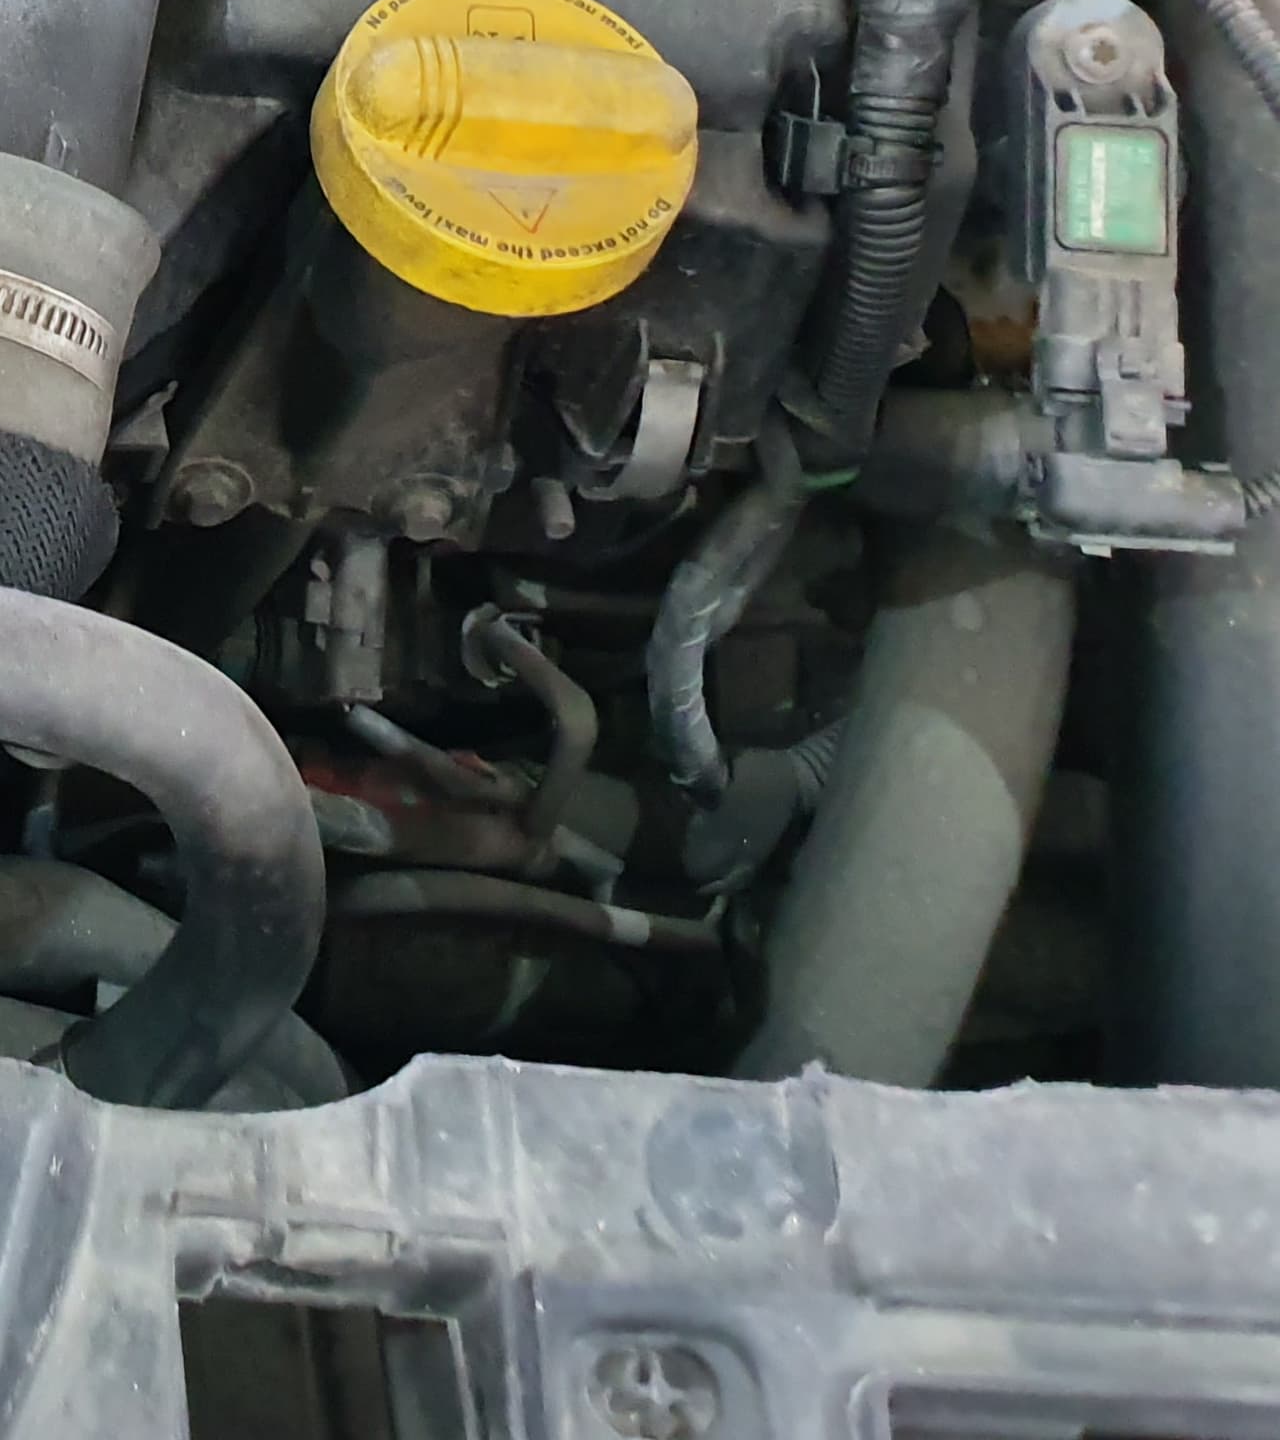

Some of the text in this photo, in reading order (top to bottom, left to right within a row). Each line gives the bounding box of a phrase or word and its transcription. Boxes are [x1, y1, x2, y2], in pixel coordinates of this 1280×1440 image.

[365, 9, 389, 30] Ne
[600, 13, 645, 51] maxi
[647, 197, 672, 219] Do
[434, 215, 489, 248] maxi
[618, 218, 649, 243] not
[496, 242, 534, 260] the
[540, 237, 617, 262] exceed
